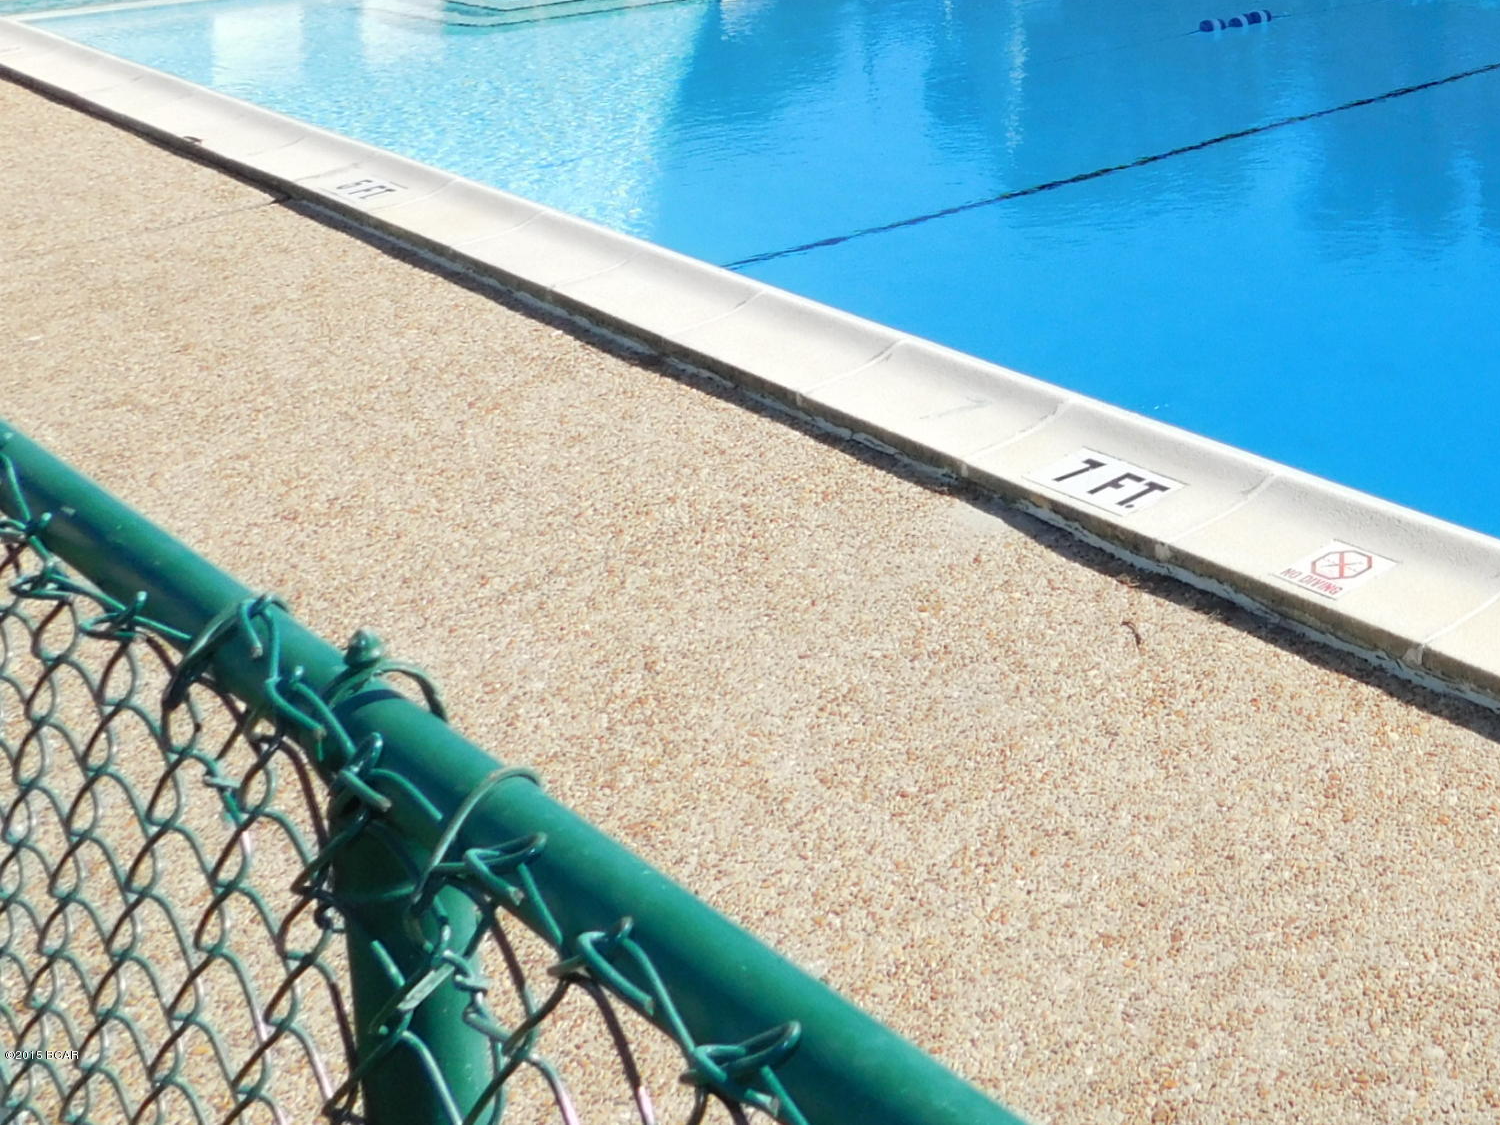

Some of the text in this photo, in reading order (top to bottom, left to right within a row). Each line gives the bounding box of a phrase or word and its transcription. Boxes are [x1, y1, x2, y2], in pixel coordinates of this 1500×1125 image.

[1053, 458, 1106, 482] 7
[1280, 568, 1343, 595] NO DIVING
